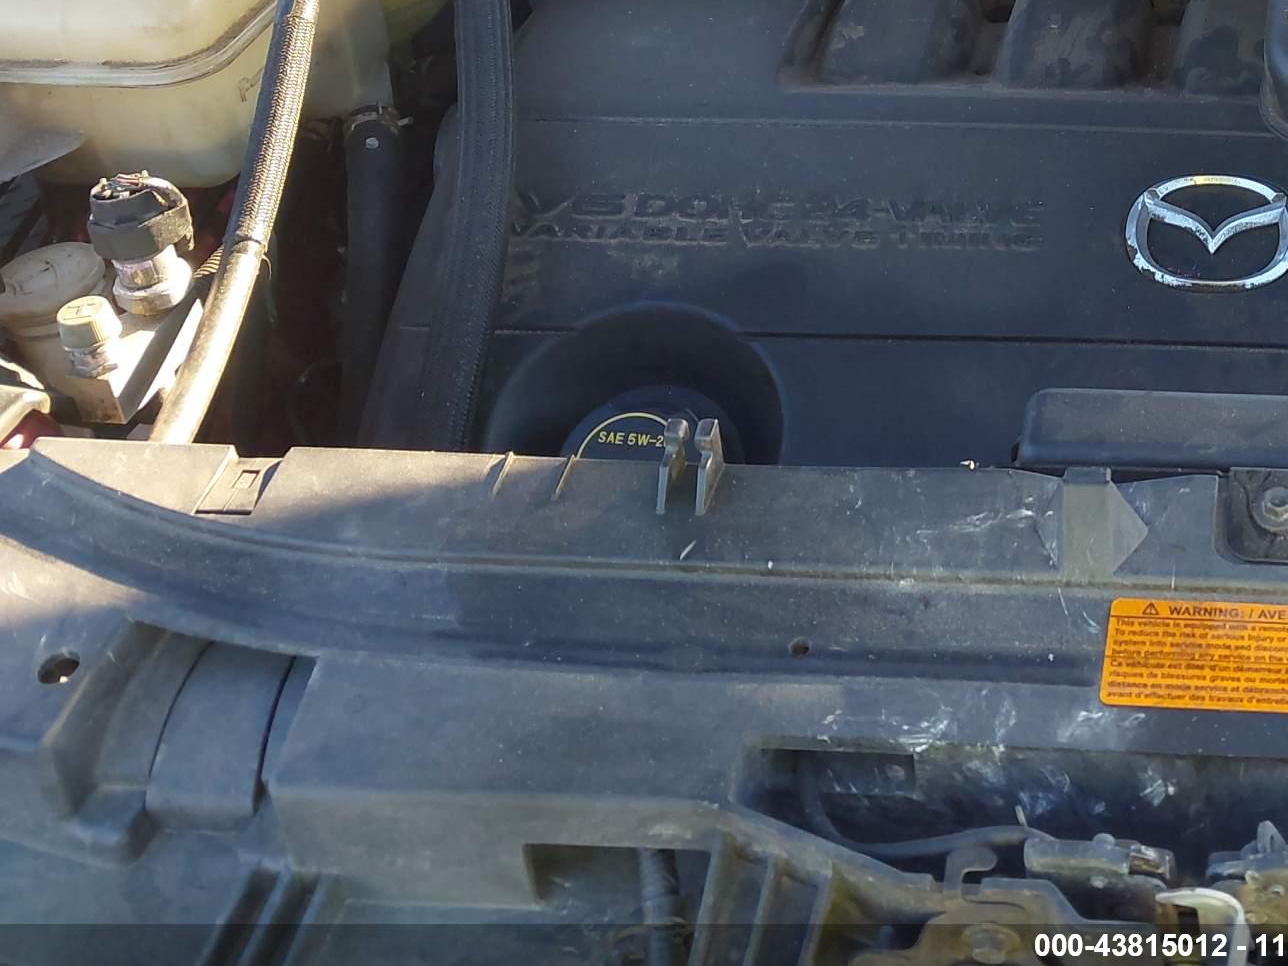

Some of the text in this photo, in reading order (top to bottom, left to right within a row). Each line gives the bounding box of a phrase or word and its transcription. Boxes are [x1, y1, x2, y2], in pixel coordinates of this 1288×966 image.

[598, 431, 665, 447] SAE 5W-2
[1248, 608, 1253, 619] /
